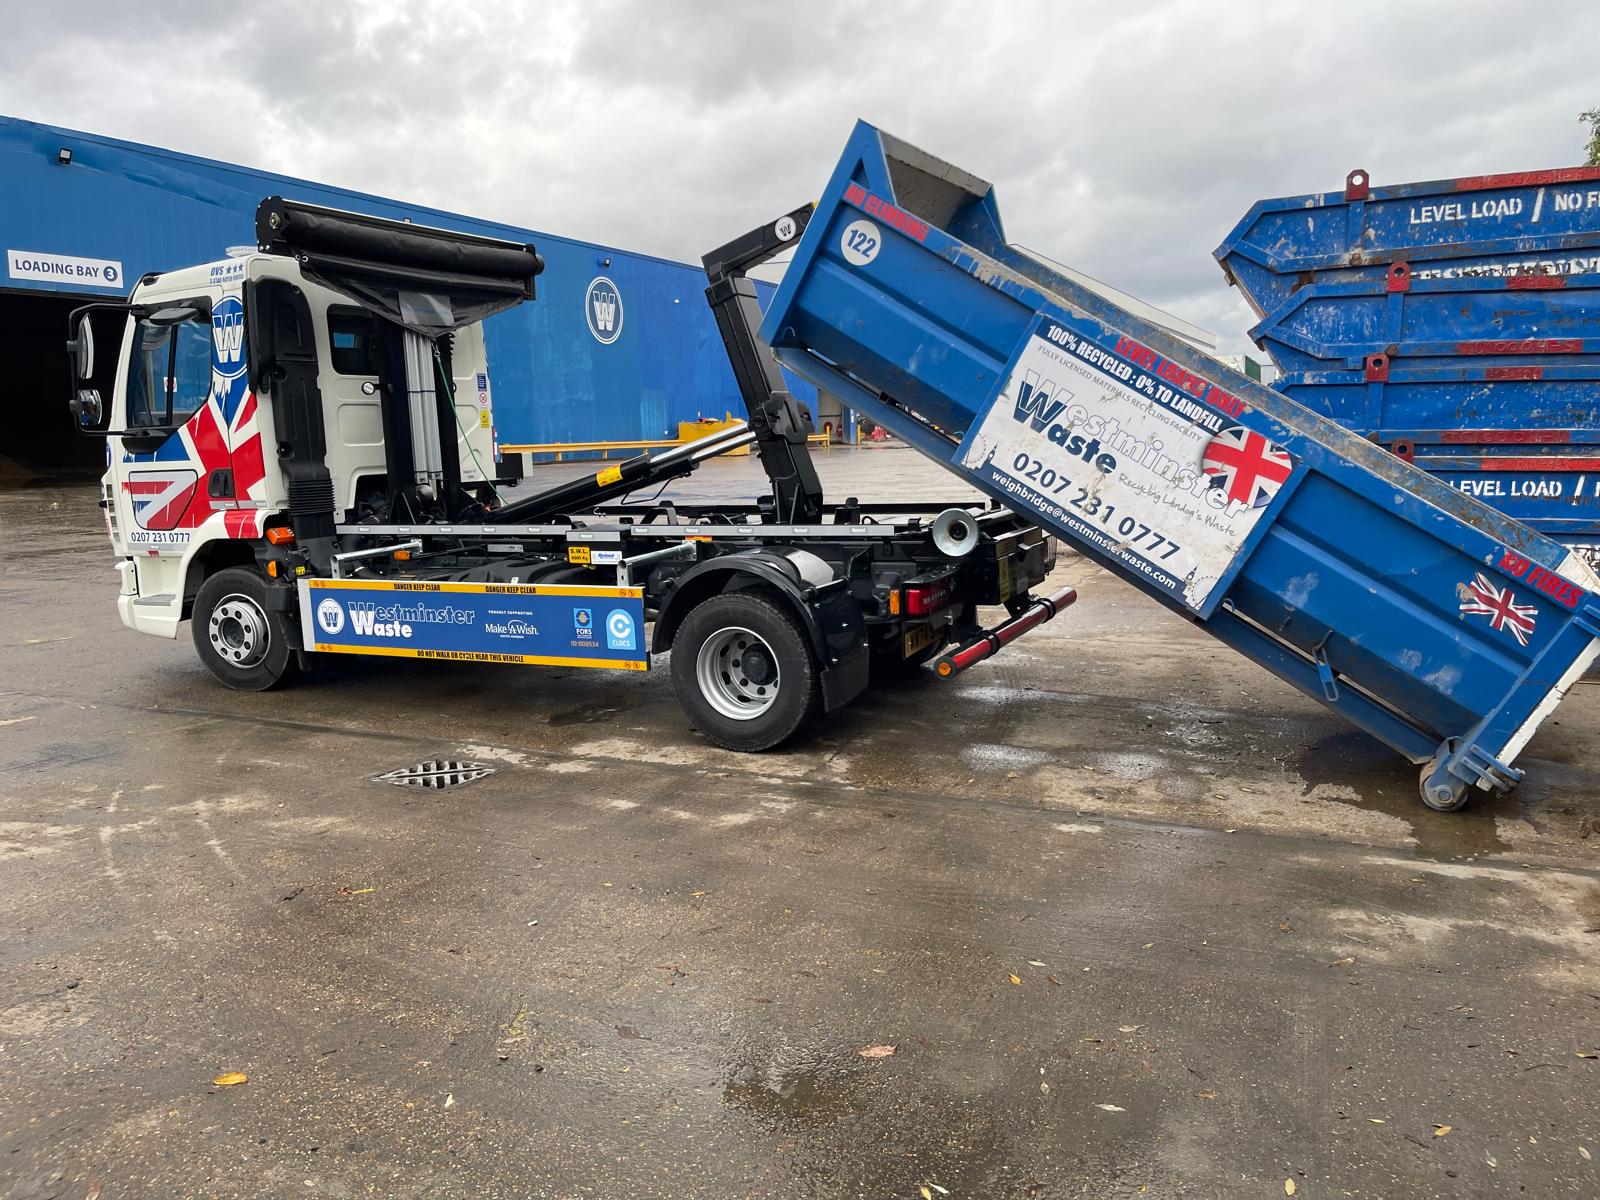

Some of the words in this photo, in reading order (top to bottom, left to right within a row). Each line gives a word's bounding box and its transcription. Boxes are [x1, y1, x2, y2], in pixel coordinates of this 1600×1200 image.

[864, 194, 929, 242] CLIMBING
[1410, 203, 1467, 224] LEVEL
[1471, 198, 1523, 219] LOAD
[1555, 192, 1583, 211] NO
[846, 229, 877, 258] 122
[15, 259, 73, 275] LOADING
[76, 265, 99, 277] BAY
[107, 268, 115, 279] 3
[592, 290, 615, 332] W
[212, 313, 244, 363] W
[1039, 345, 1060, 361] FULLY
[1059, 357, 1092, 380] LICENSED
[1093, 376, 1131, 402] MATERIALS
[1131, 398, 1170, 424] RECYCLING
[1169, 419, 1203, 442] FACILITY
[1047, 325, 1076, 351] 100%
[1076, 341, 1132, 381] RECYCLED
[1135, 375, 1157, 394] 0%
[1154, 385, 1172, 403] TO
[1170, 394, 1225, 433] LANDFILL
[1114, 335, 1158, 371] LEVEL
[1206, 385, 1248, 418] ONLY
[1013, 381, 1117, 474] Waste
[1018, 368, 1250, 519] Westminster
[1013, 453, 1071, 494] 0207
[1070, 487, 1116, 524] 231
[1118, 516, 1181, 560] 0777
[1118, 473, 1162, 504] Recycling
[1162, 494, 1202, 521] London's
[1205, 514, 1237, 537] Waste
[1511, 480, 1563, 497] LOAD
[131, 532, 150, 542] 0207
[152, 532, 167, 543] 231
[169, 533, 190, 543] 0777
[992, 471, 1177, 590] weighbridge@westminsterwaste.com
[394, 583, 413, 591] DANGER
[425, 584, 441, 592] CLEAR
[506, 586, 519, 594] KEEP
[1497, 551, 1531, 577] NO
[1526, 566, 1584, 608] FIRES
[348, 602, 475, 627] Westminster
[350, 610, 413, 638] Waste
[425, 650, 435, 658] NOT
[451, 651, 459, 659] OR
[459, 652, 475, 660] CYCLE
[475, 653, 490, 661] NEAR
[490, 654, 502, 662] THIS
[502, 655, 525, 663] VEHICLE
